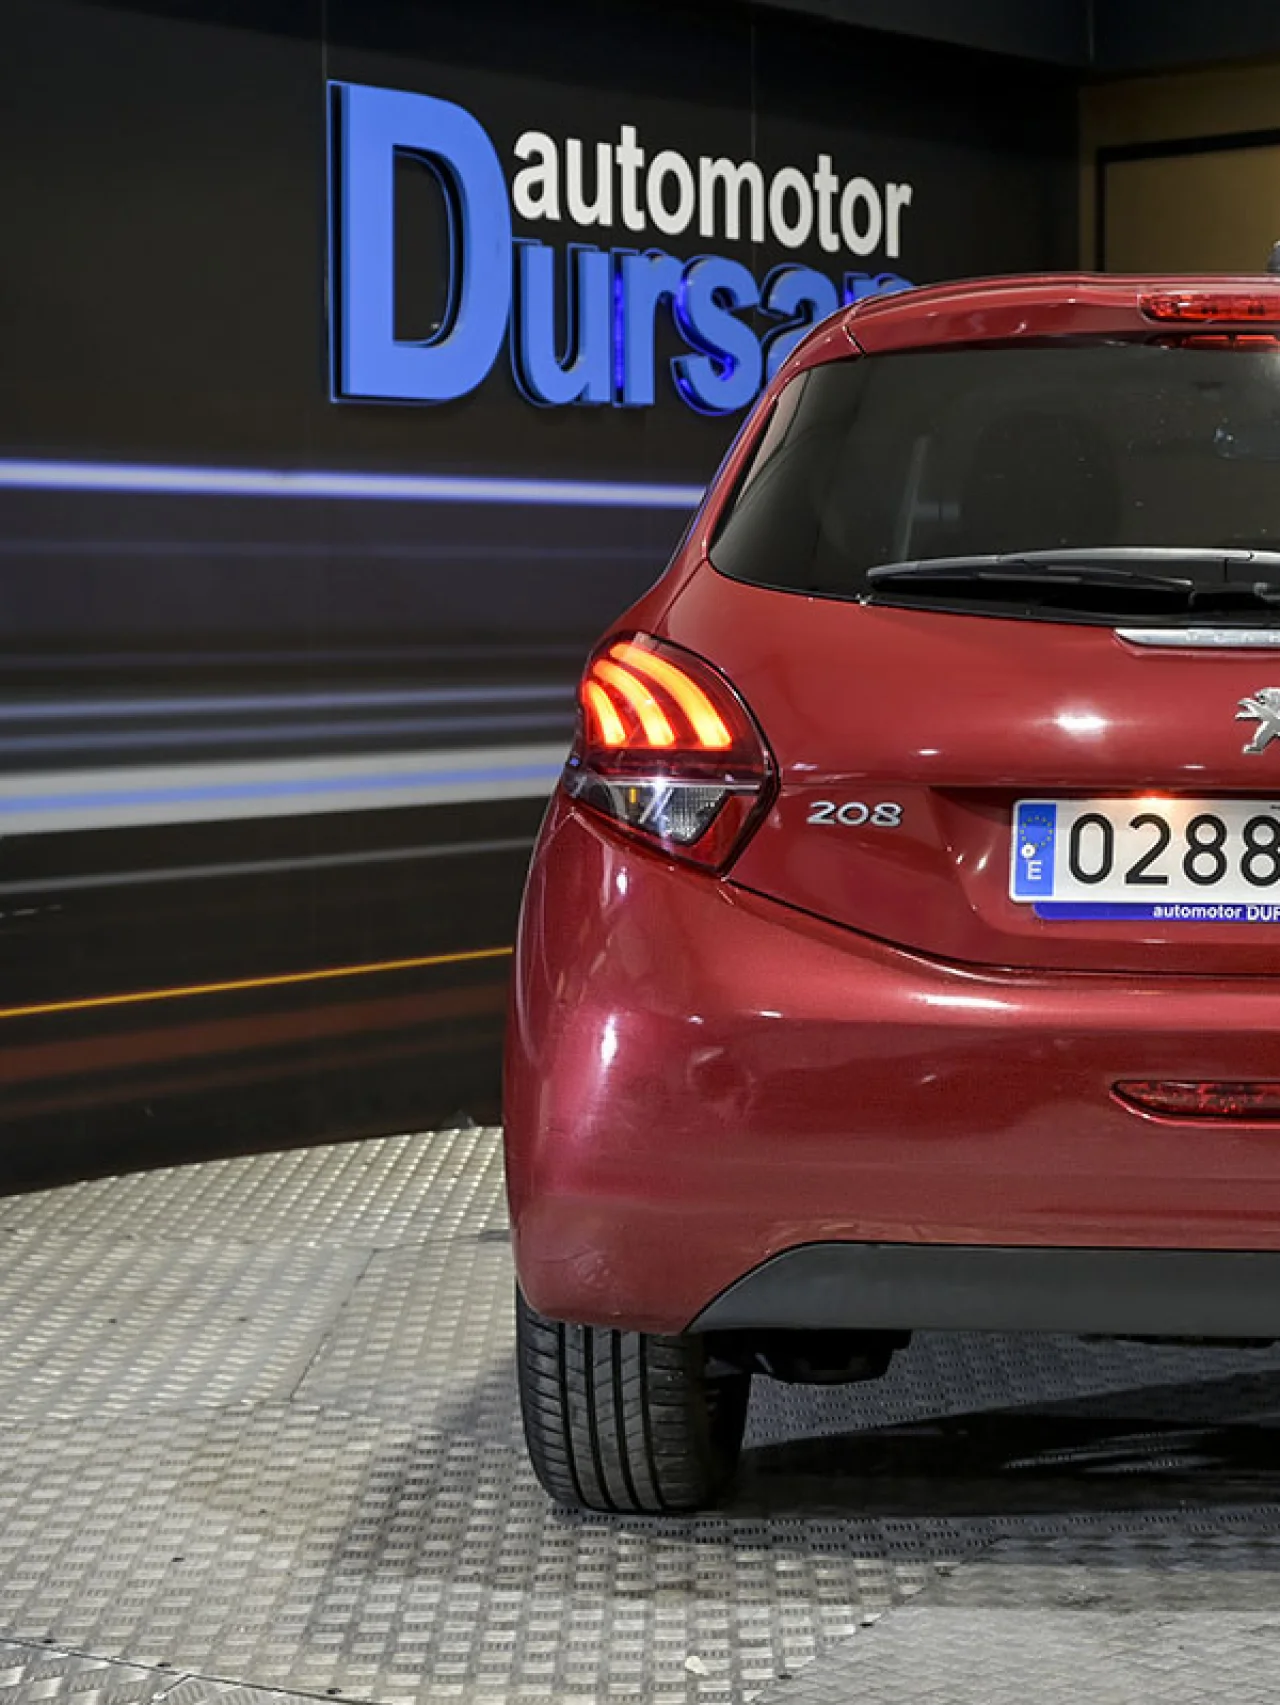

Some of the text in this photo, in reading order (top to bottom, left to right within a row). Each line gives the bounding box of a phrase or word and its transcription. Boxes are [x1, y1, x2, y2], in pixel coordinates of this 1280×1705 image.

[512, 124, 912, 258] automotor
[326, 80, 914, 415] Dursa
[806, 800, 903, 827] 208
[1027, 860, 1042, 880] E
[1153, 904, 1242, 919] automotor
